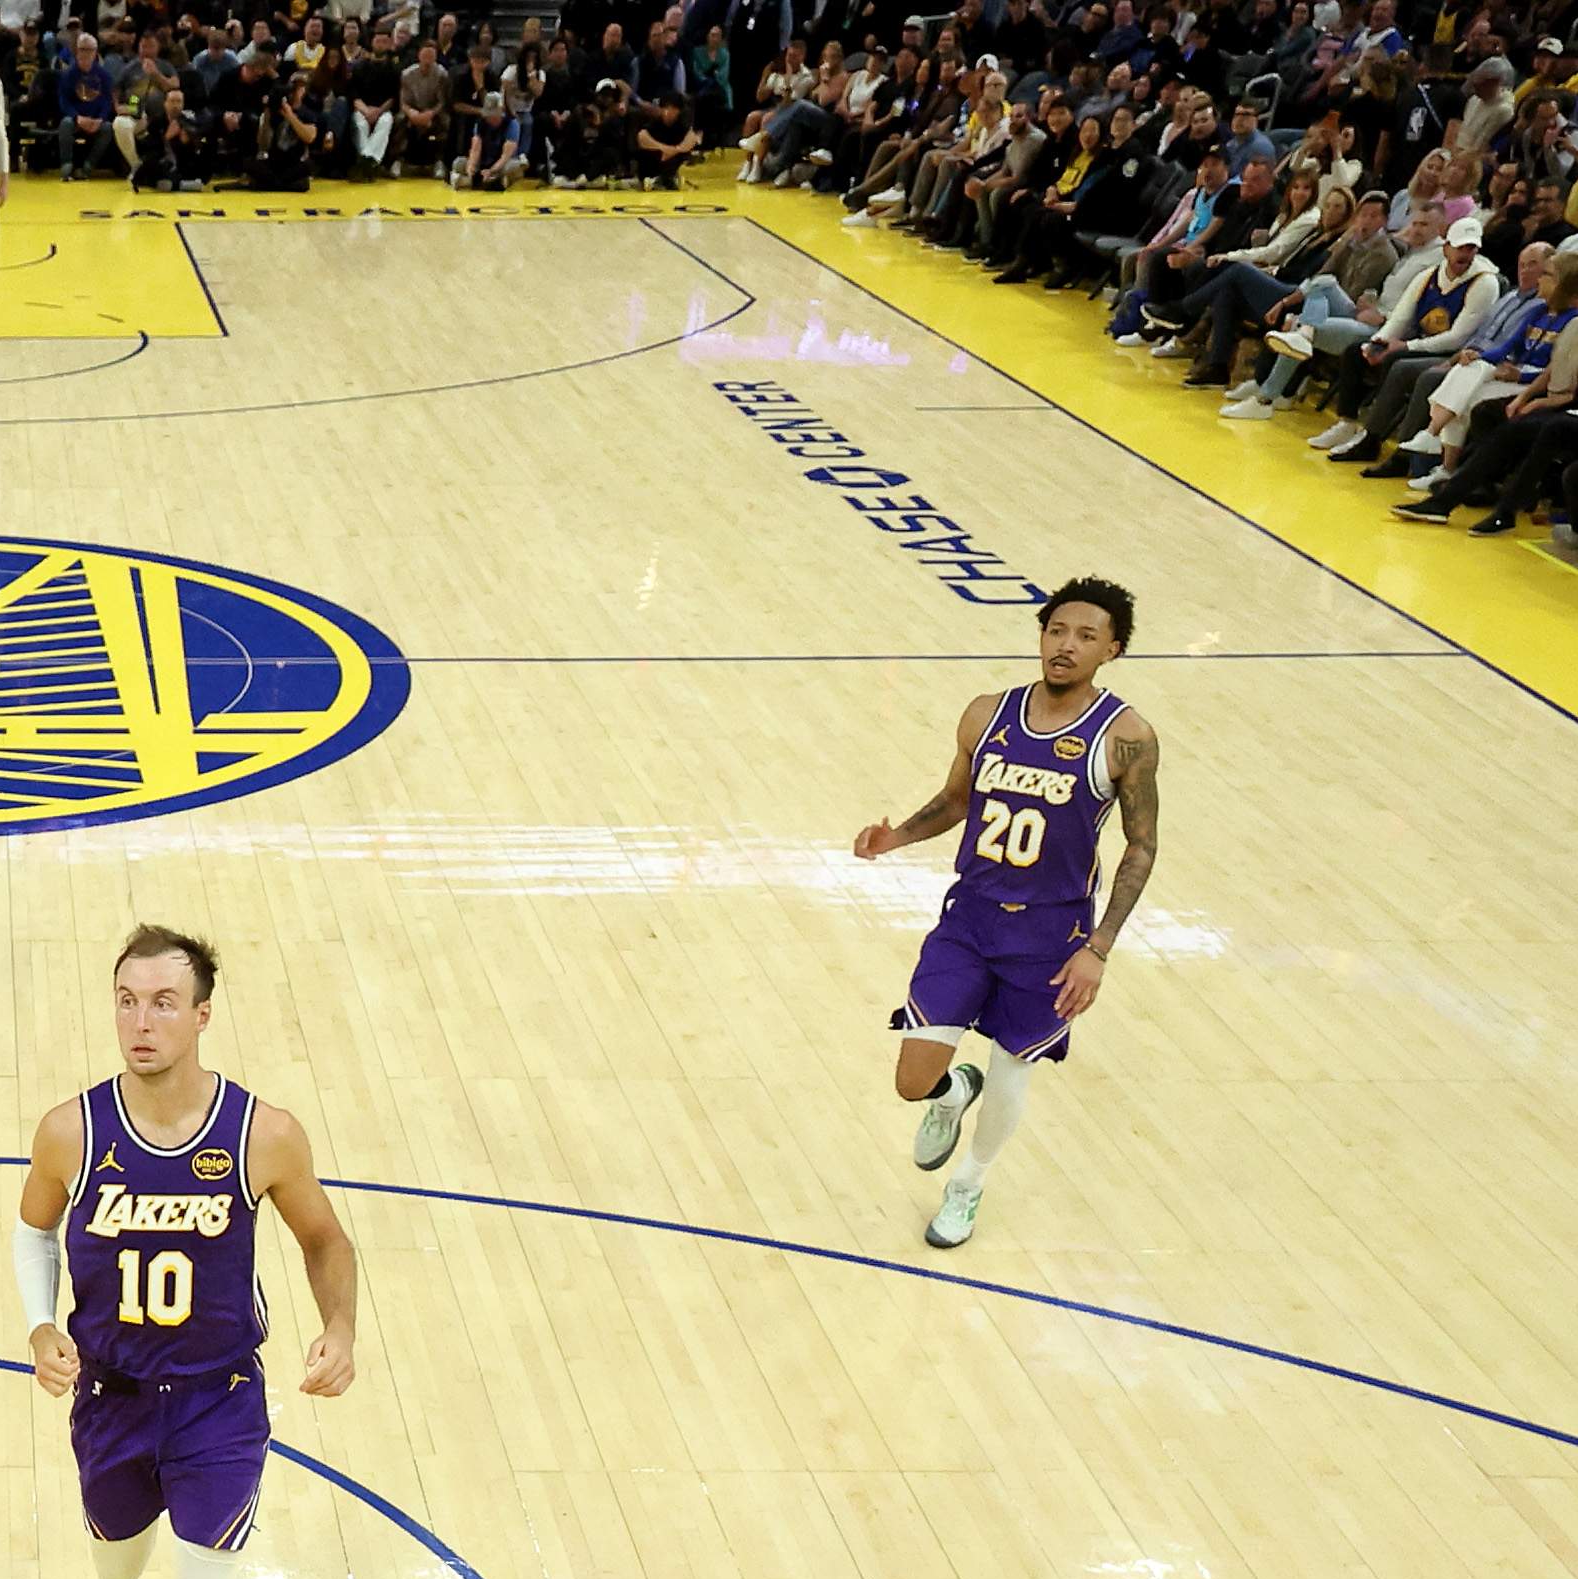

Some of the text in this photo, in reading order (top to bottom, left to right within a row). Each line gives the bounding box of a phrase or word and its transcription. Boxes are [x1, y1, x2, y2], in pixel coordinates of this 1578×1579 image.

[79, 204, 730, 219] SAN FRANCISCO
[711, 379, 1053, 605] CHASE CENTER
[974, 752, 1079, 806] LAKERS
[975, 799, 1048, 869] 20
[85, 1183, 234, 1238] LAKERS
[118, 1248, 194, 1327] 10
